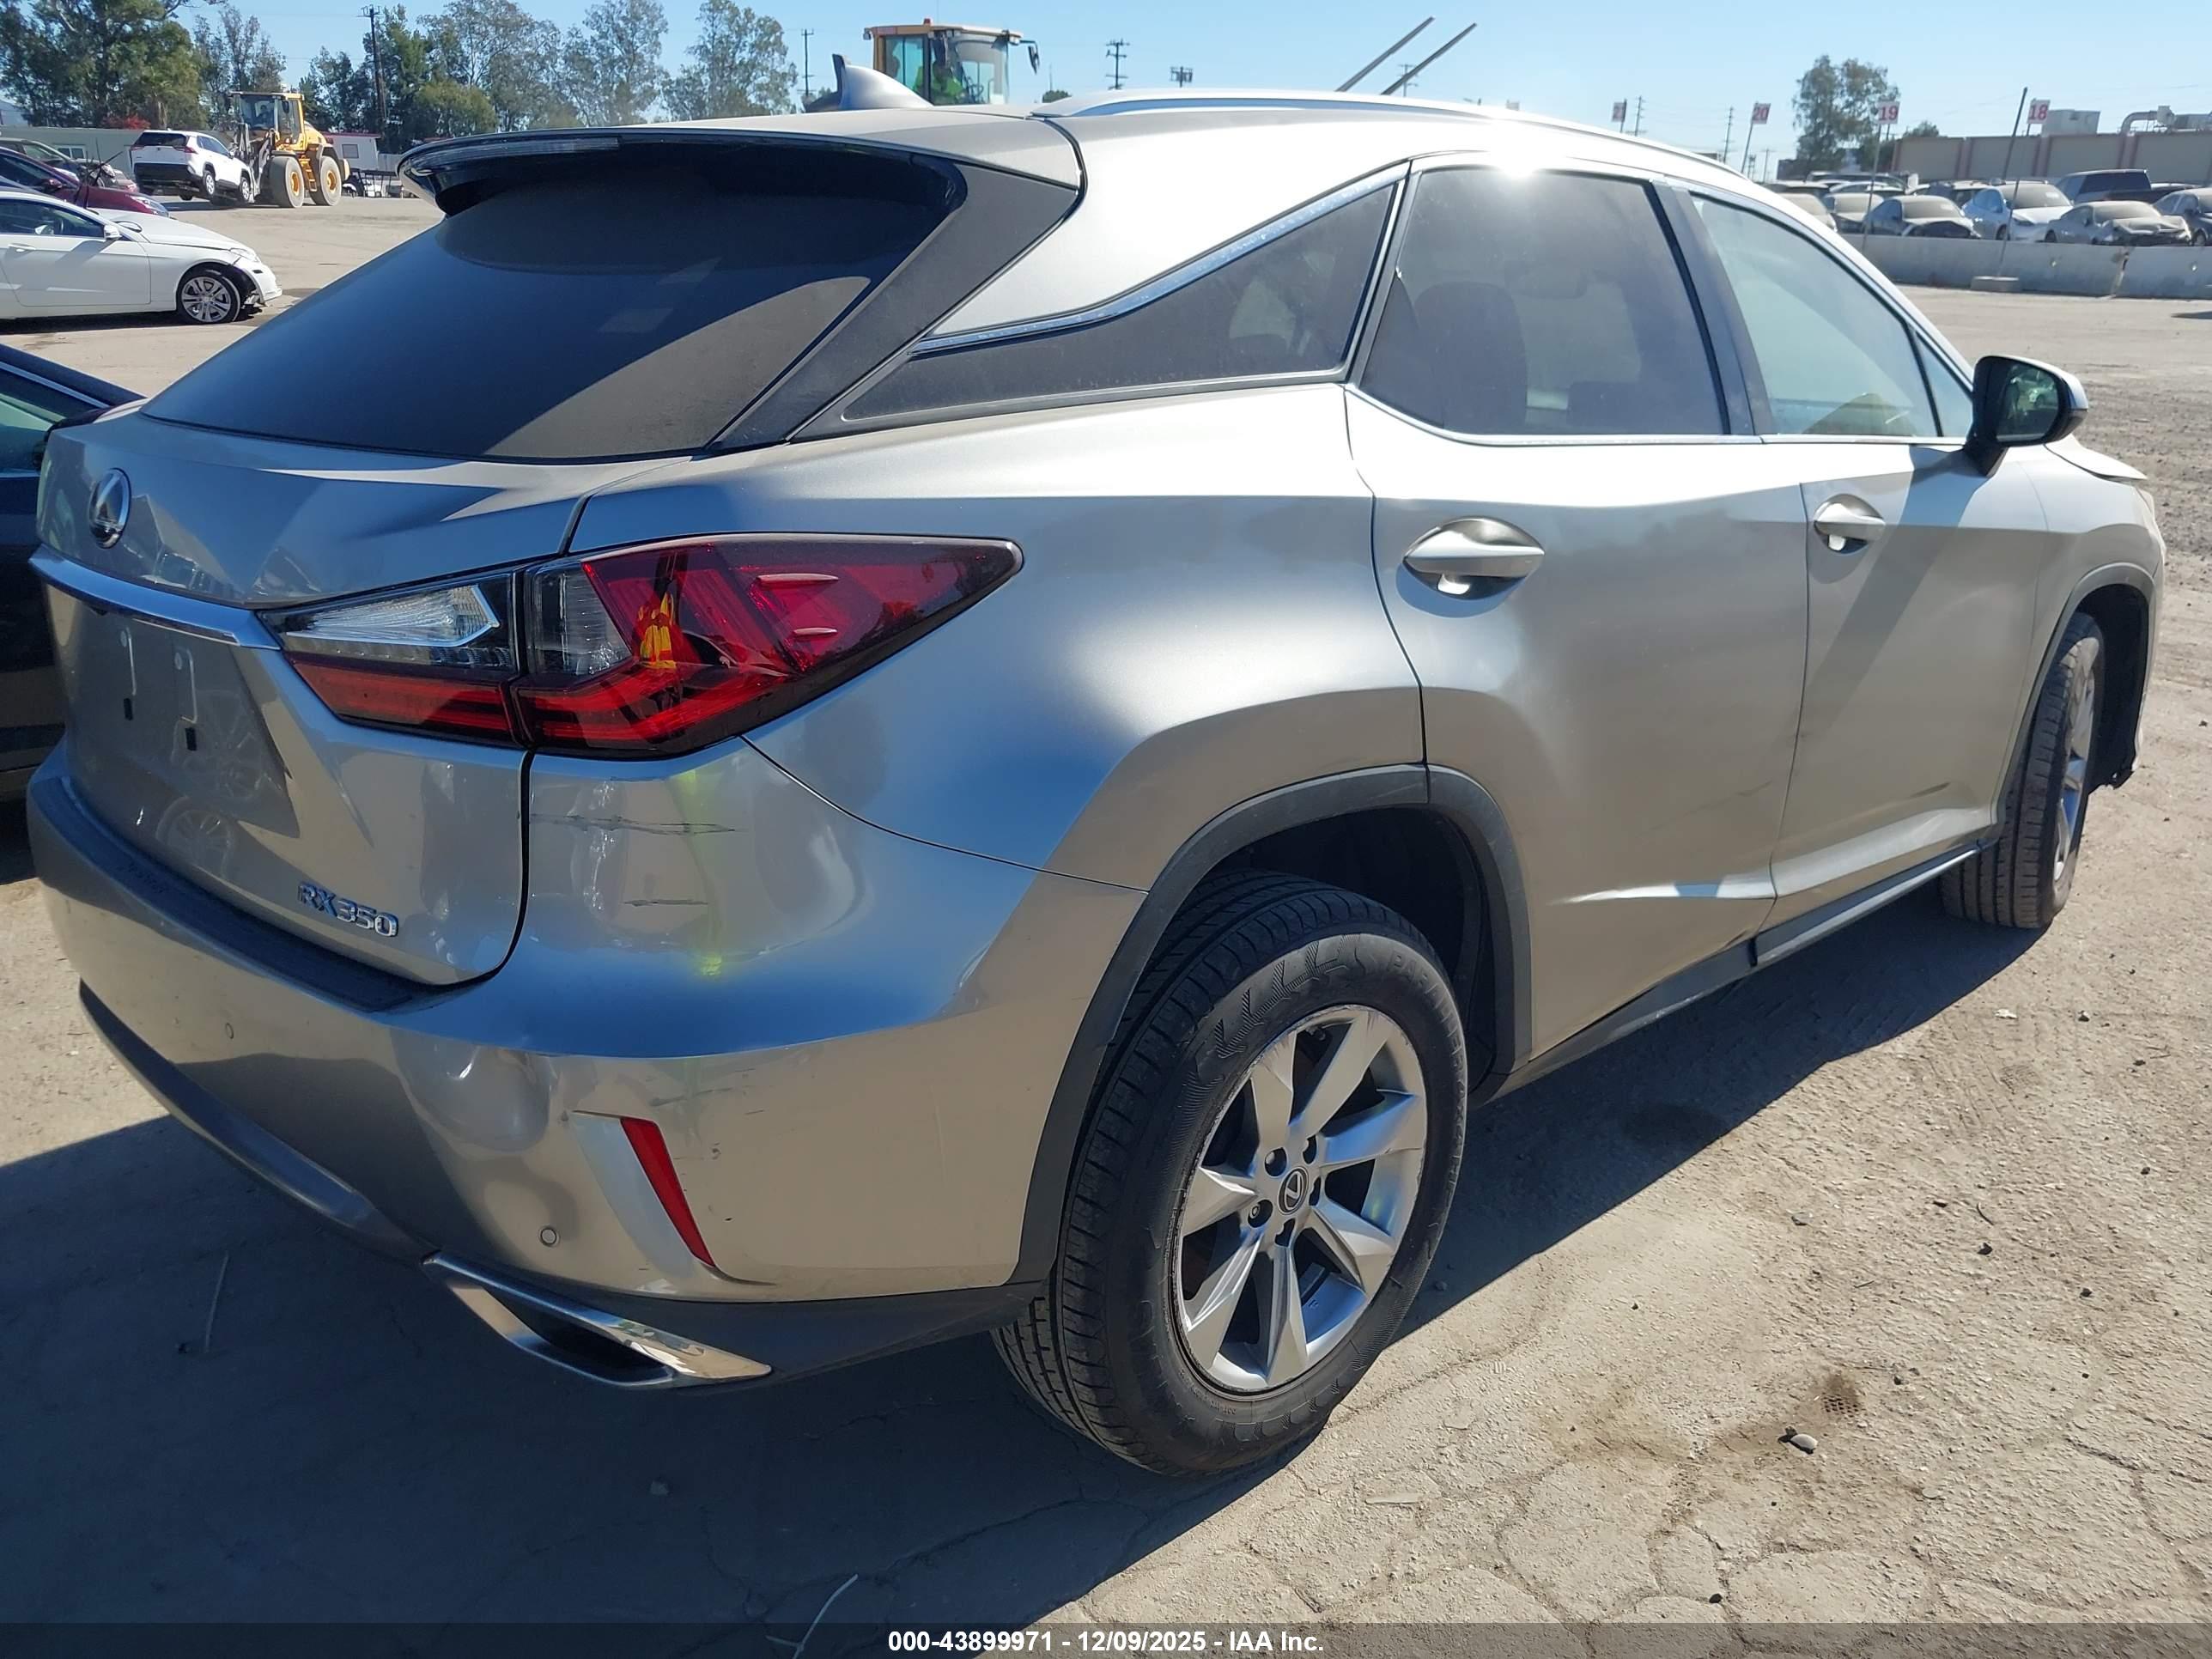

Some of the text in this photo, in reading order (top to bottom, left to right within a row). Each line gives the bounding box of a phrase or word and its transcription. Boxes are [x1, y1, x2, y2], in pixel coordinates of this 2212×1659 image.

[1753, 106, 1769, 120] 20
[1879, 106, 1898, 120] 19
[2028, 104, 2048, 120] 18
